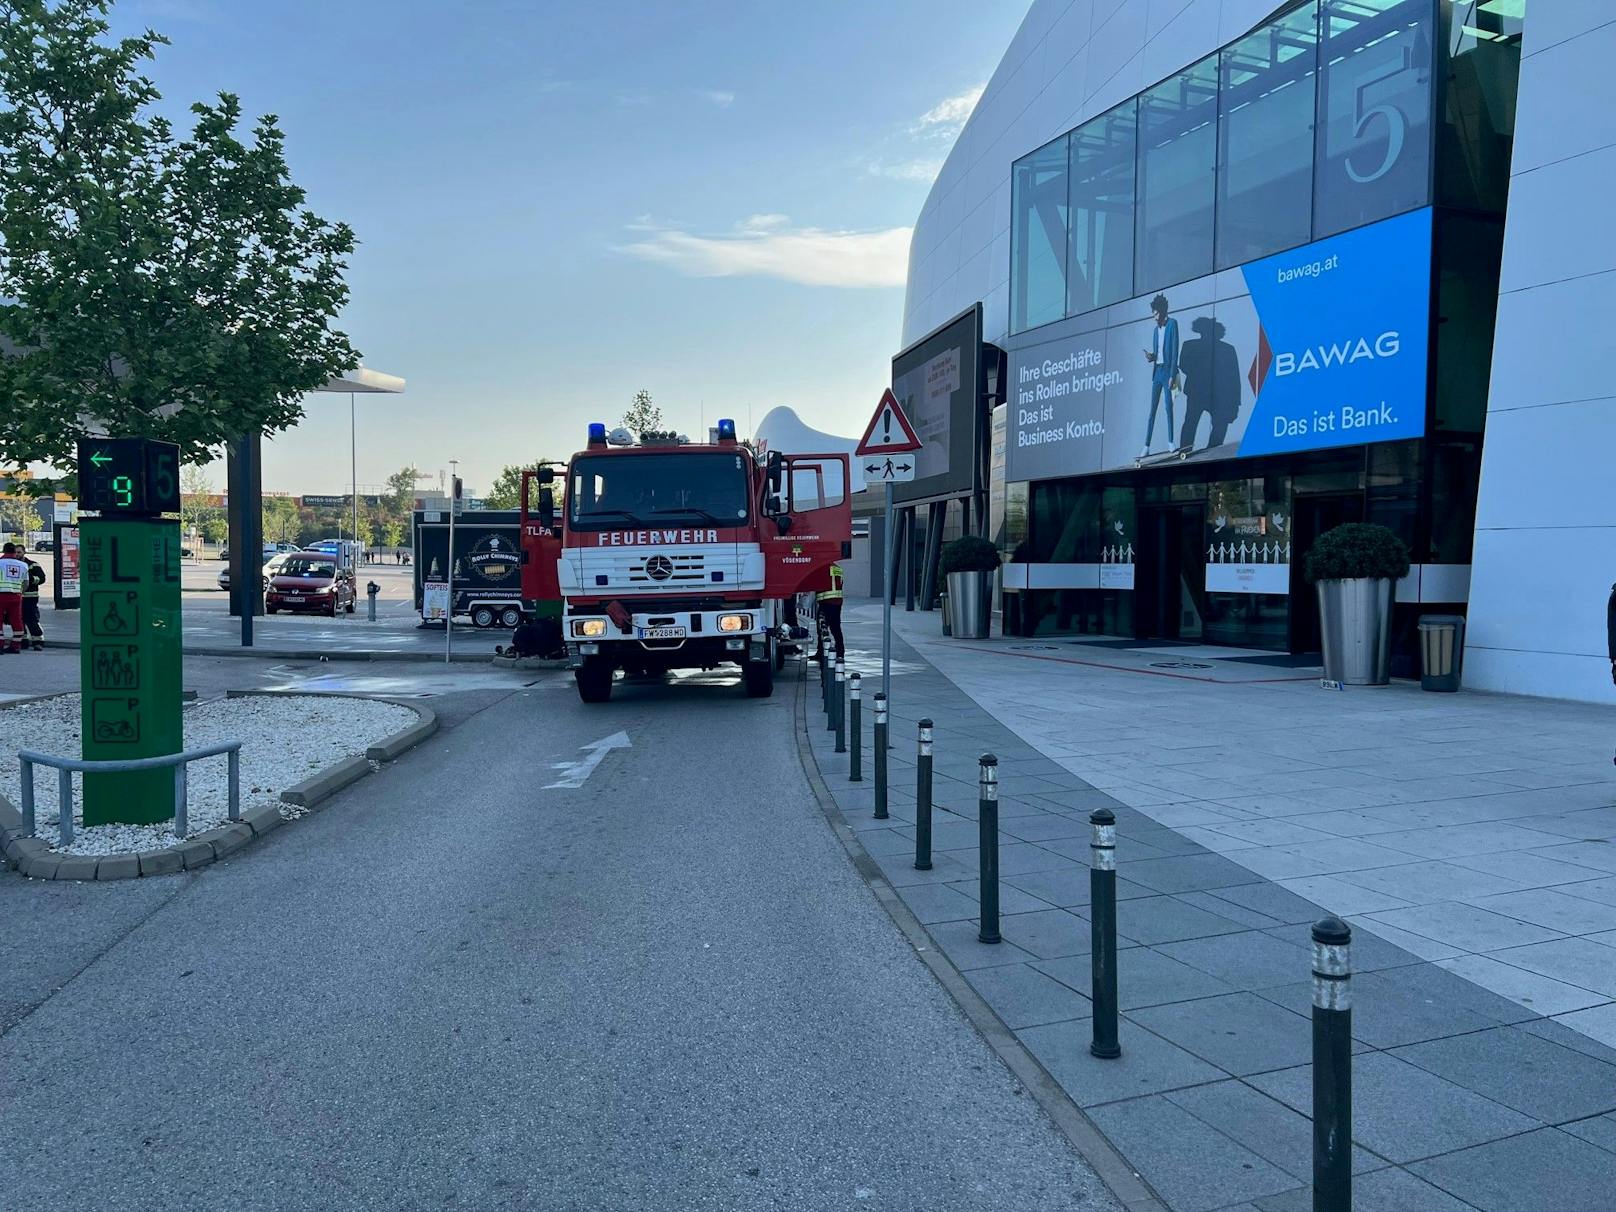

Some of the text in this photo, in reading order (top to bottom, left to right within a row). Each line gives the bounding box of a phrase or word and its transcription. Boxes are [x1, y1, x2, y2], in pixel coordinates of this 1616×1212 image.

[1344, 46, 1410, 183] 5
[1278, 254, 1338, 283] bawag.at
[1020, 349, 1102, 383] Ihre Geschäfte
[1275, 331, 1400, 376] BAWAG
[1019, 370, 1124, 405] ins Rollen bringen.
[1019, 409, 1039, 426] Das
[1040, 404, 1054, 422] ist
[1274, 400, 1399, 437] Das ist Bank.
[1018, 420, 1105, 447] Business Konto.
[113, 476, 132, 506] 9
[599, 529, 718, 546] FEUERWEHR
[88, 536, 102, 583] REIHE
[111, 536, 140, 583] L
[471, 553, 490, 563] ROLLY
[644, 630, 655, 638] FW
